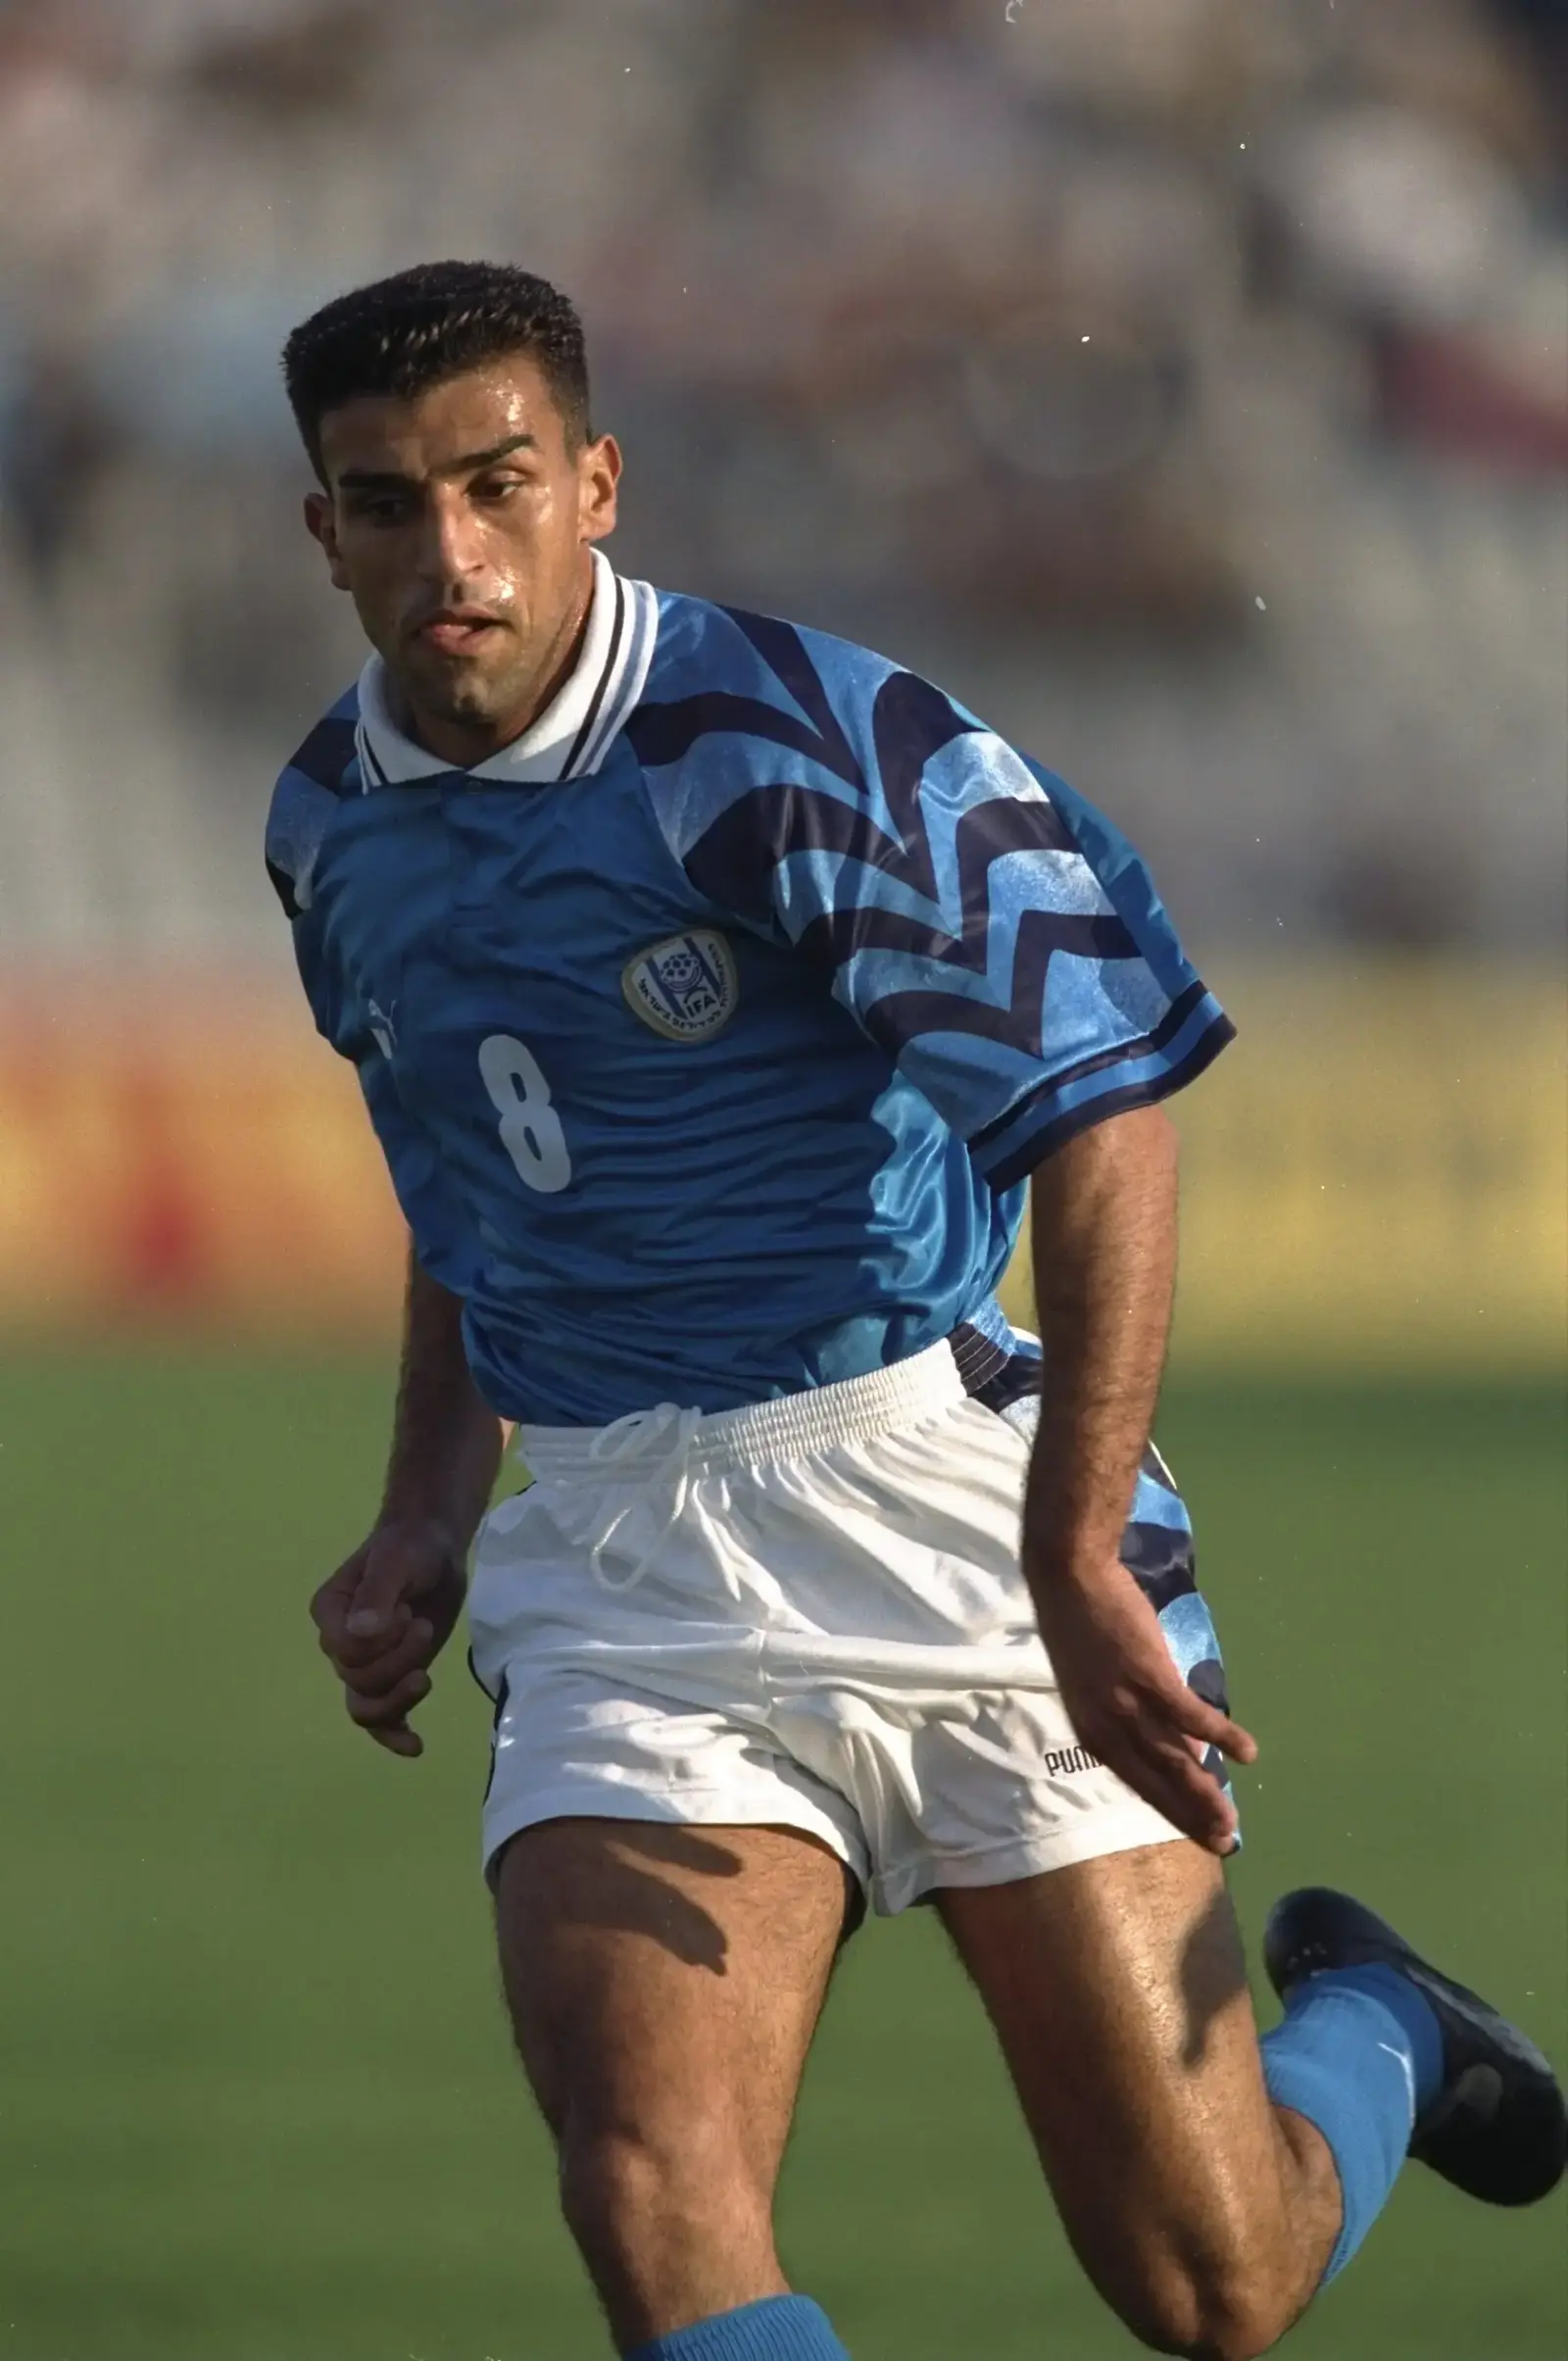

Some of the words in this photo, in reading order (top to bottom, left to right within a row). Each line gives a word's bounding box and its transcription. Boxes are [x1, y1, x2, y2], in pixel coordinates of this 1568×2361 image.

[685, 994, 716, 1017] IFA
[478, 1034, 571, 1193] 8
[1045, 1746, 1101, 1777] PUM
